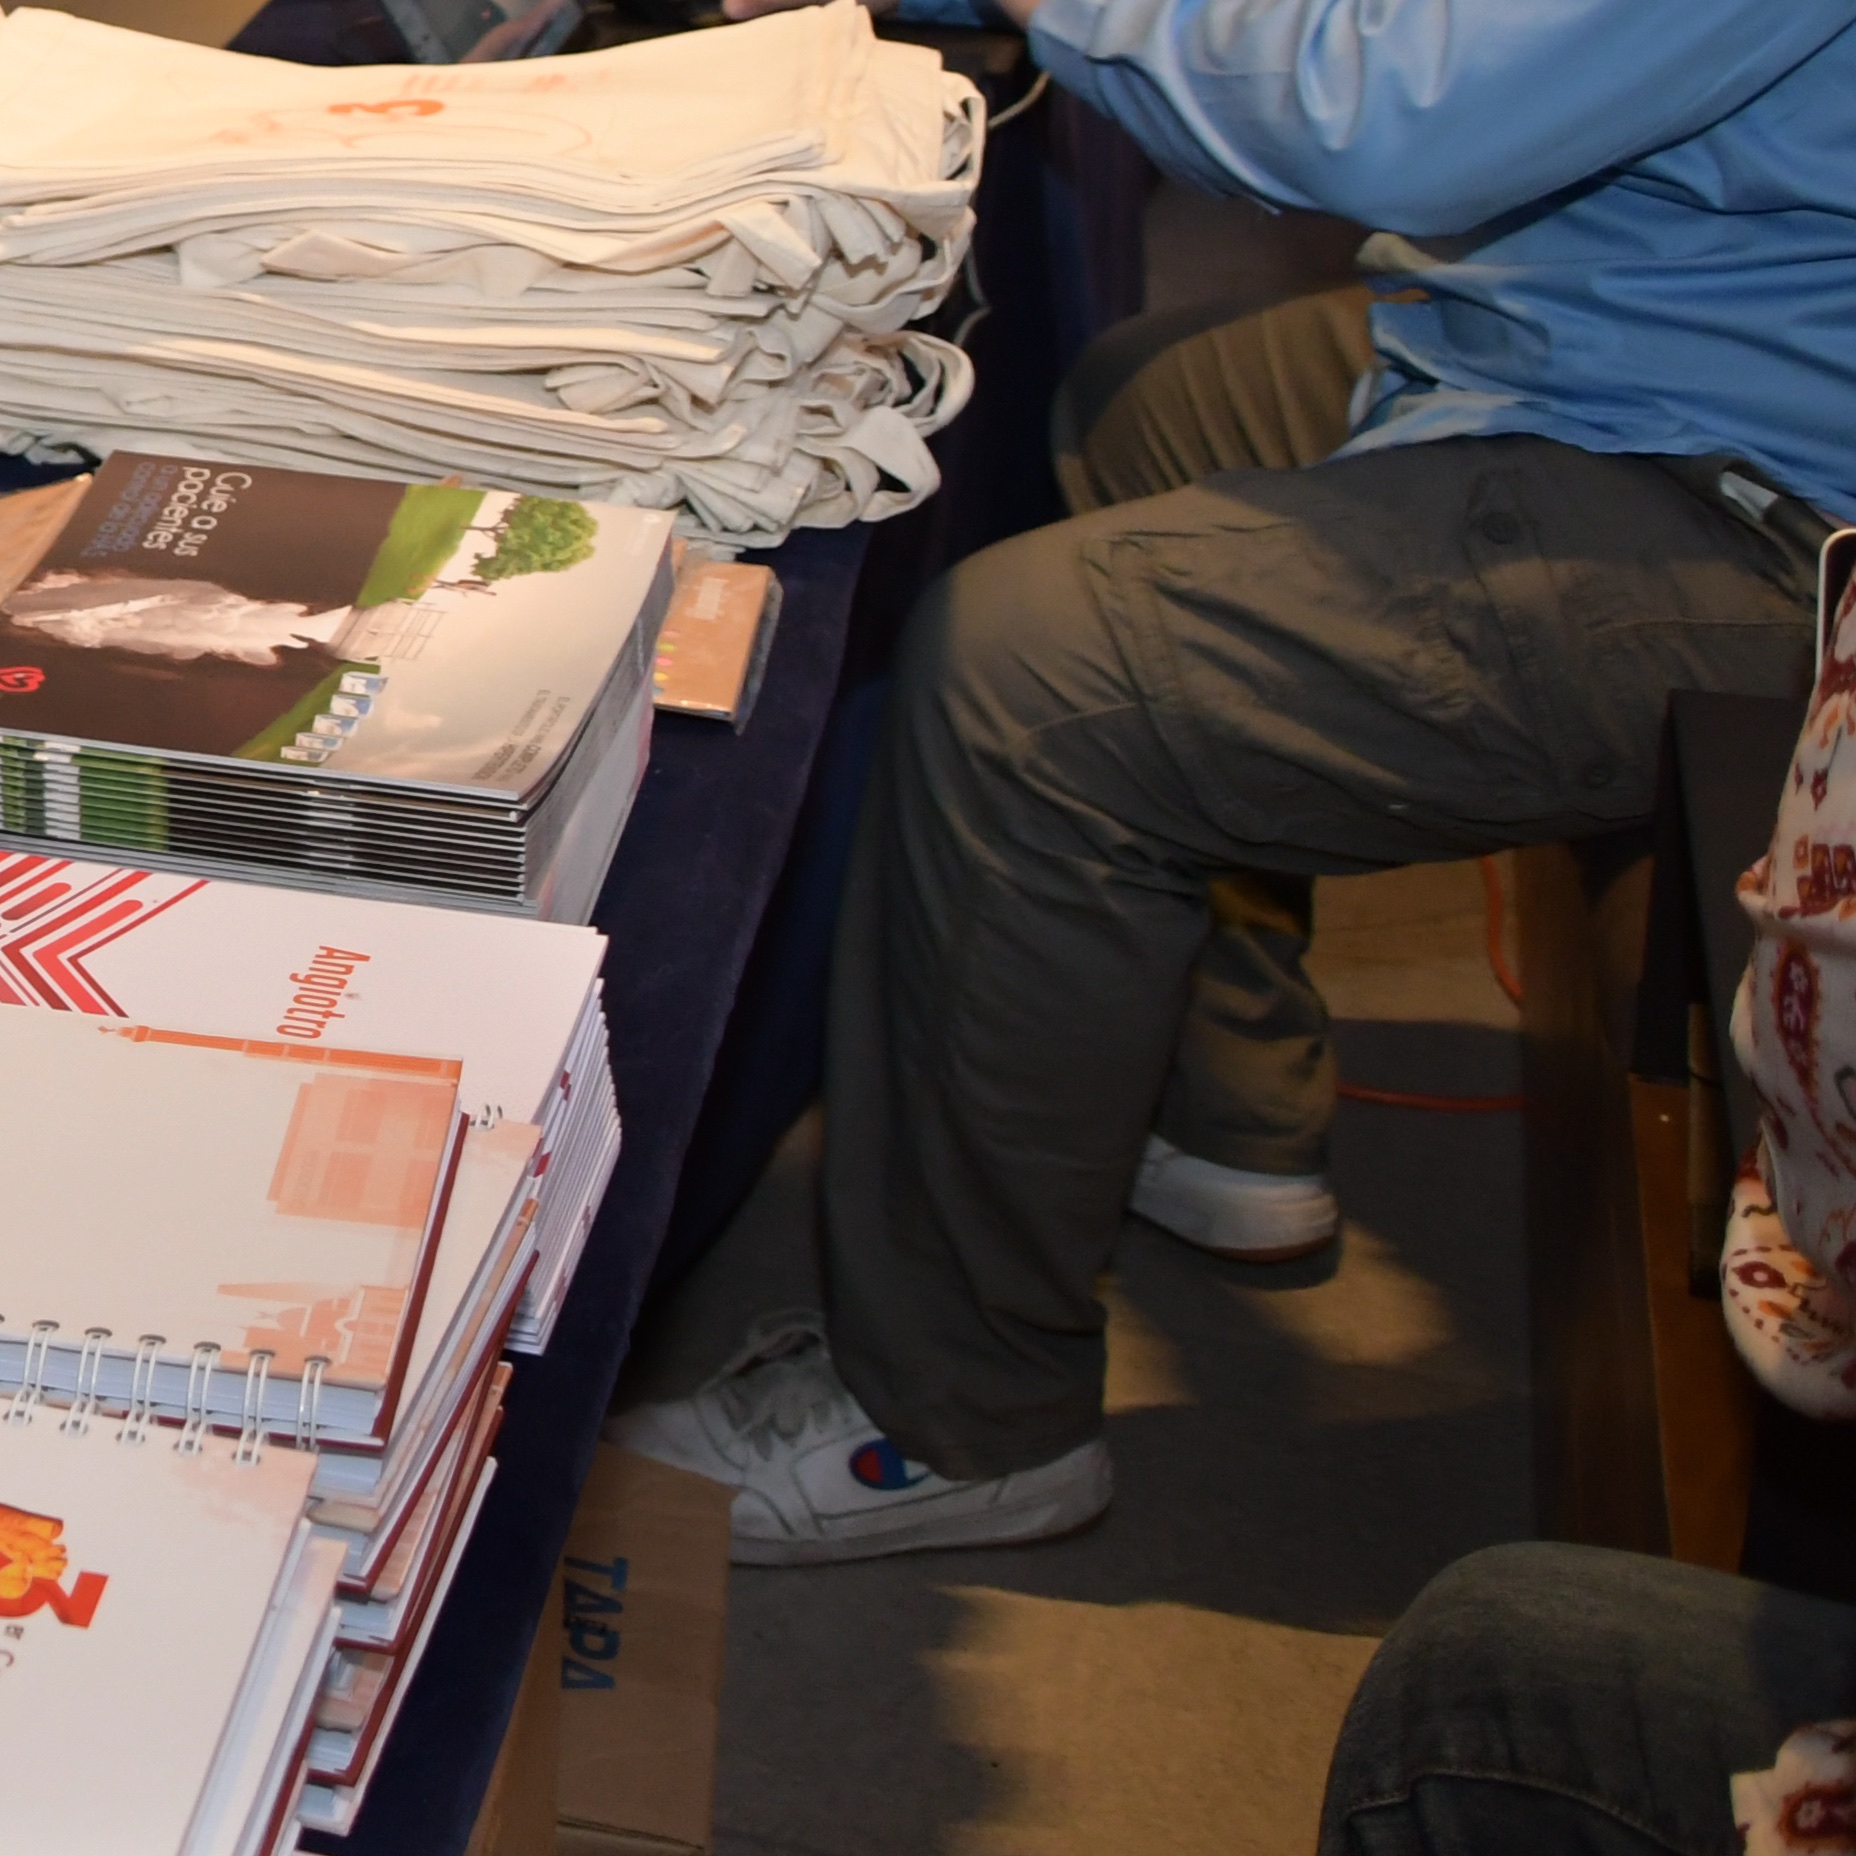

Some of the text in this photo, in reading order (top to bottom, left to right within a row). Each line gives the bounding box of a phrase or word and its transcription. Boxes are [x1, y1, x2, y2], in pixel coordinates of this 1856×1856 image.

[141, 466, 211, 550] pacientes
[173, 531, 208, 557] sus
[561, 1556, 629, 1690] TAPA
